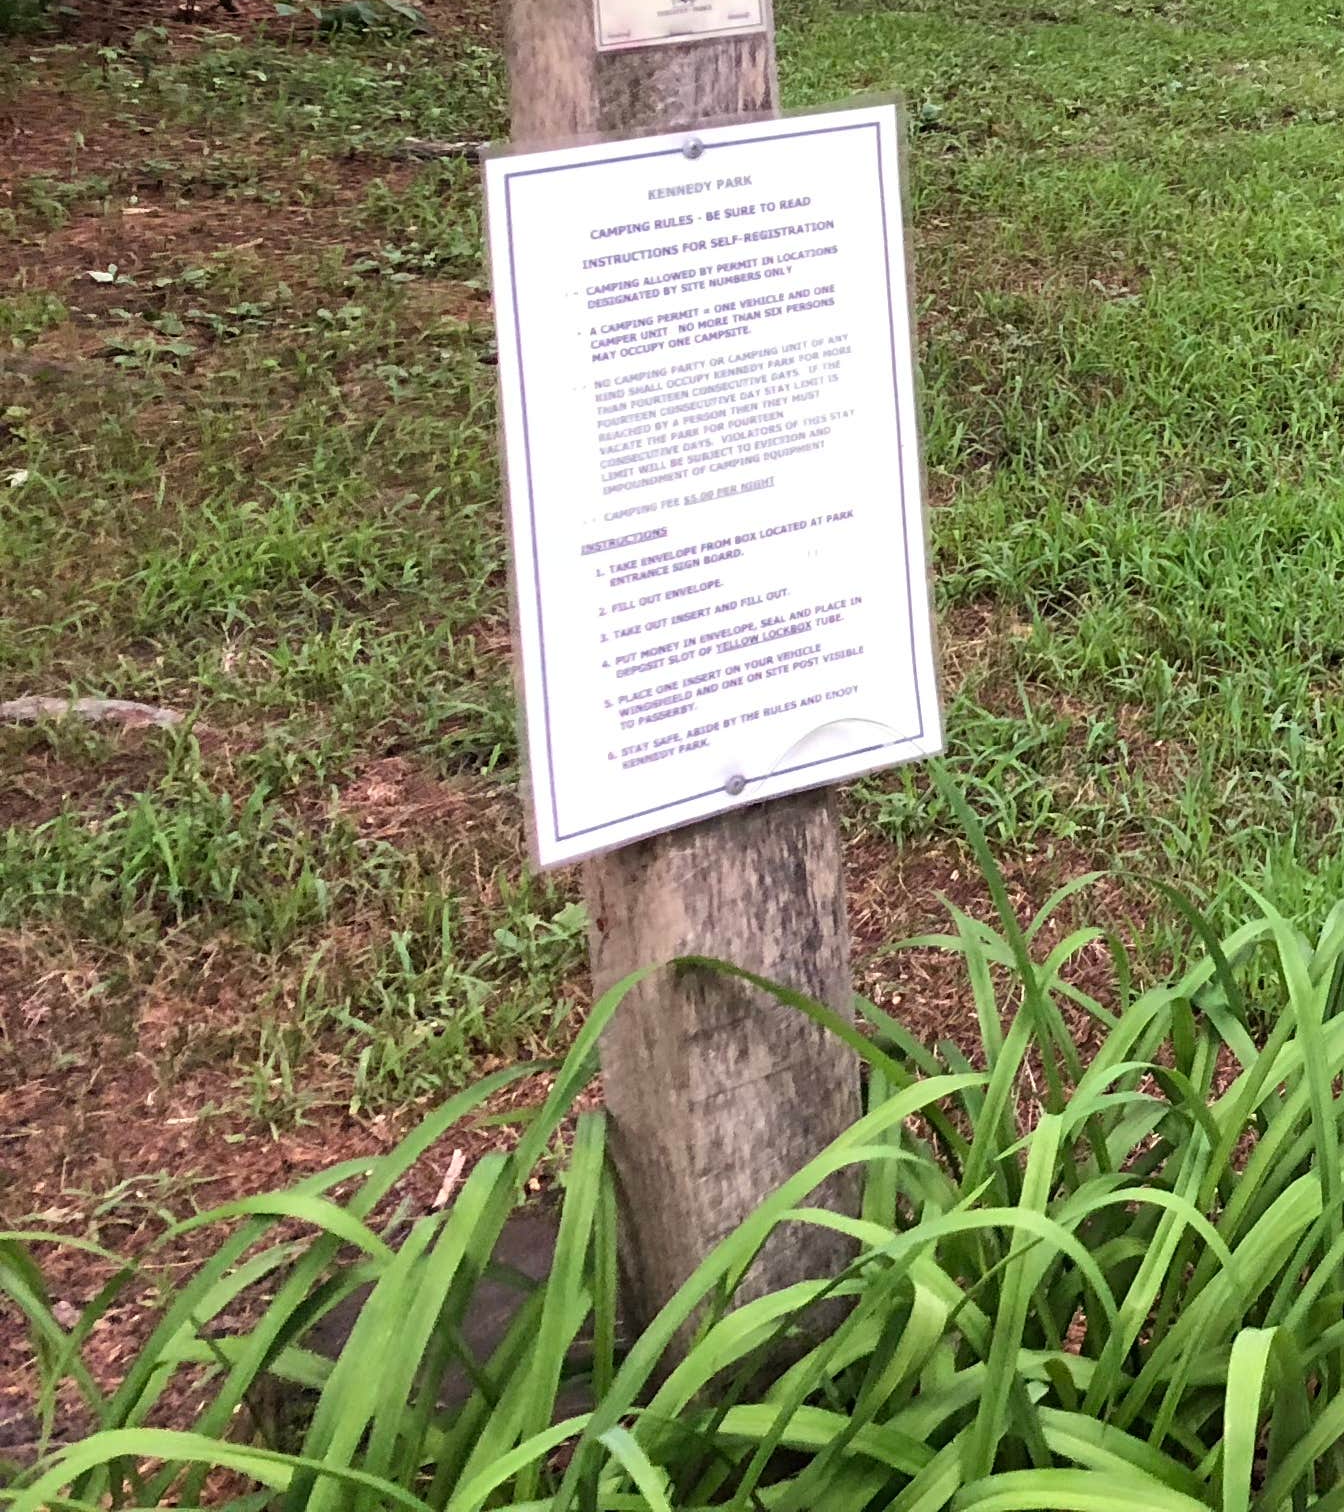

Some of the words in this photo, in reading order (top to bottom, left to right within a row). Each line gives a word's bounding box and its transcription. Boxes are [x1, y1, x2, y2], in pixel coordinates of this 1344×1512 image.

[647, 181, 712, 200] KENNEDY
[716, 175, 753, 190] PARK
[590, 221, 651, 240] CAMPING
[654, 214, 694, 229] RULES
[705, 210, 721, 222] BE
[723, 205, 756, 219] SURE
[759, 202, 776, 213] TO
[779, 197, 812, 210] READ
[582, 245, 679, 269] INSTRUCTIONS
[682, 240, 707, 252] FOR
[710, 220, 835, 248] SELF-REGISTRATION
[586, 278, 640, 296] CAMPING
[643, 269, 697, 285] ALLOWED
[699, 266, 713, 276] BY
[716, 258, 758, 273] PERMIT
[761, 256, 775, 266] IN
[776, 245, 839, 263] LOCATIONS
[587, 288, 661, 309] DESIGNATED
[662, 286, 677, 296] BY
[680, 280, 706, 293] SITE
[708, 271, 762, 287] NUMBERS
[763, 266, 792, 278] ONLY
[589, 327, 597, 335] A
[600, 316, 654, 334] CAMPING
[656, 308, 699, 323] PERMIT
[713, 302, 737, 313] ONE
[739, 293, 785, 309] VEHICLE
[788, 289, 811, 300] AND
[813, 284, 835, 295] ONE
[590, 333, 638, 349] CAMPER
[640, 327, 668, 340] UNIT
[678, 322, 695, 333] NO
[697, 316, 729, 329] MORE
[732, 310, 762, 323] THAN
[764, 306, 783, 318] SIX
[785, 297, 835, 313] PERSONS
[591, 351, 616, 362] MAY
[619, 341, 665, 357] OCCUPY
[667, 336, 691, 348] ONE
[580, 526, 668, 556] INSTRUCTIONS
[609, 560, 638, 573] TAKE
[640, 545, 697, 566] ENVELOPE
[700, 538, 732, 552] FROM
[734, 532, 757, 545] BOX
[759, 520, 808, 539] LOCATED
[810, 516, 823, 527] AT
[826, 510, 854, 523] PARK
[609, 565, 669, 587] ENTRANCE
[672, 558, 701, 572] SIGN
[611, 601, 636, 613] FILL
[638, 593, 662, 606] OUT
[613, 625, 642, 639] TAKE
[644, 618, 668, 631] OUT
[670, 607, 711, 625] INSERT
[714, 601, 738, 614] AND
[740, 595, 764, 607] FILL
[615, 652, 637, 665] PUT
[640, 641, 680, 659] MONEY
[683, 638, 697, 648] IN
[760, 616, 786, 628] SEAL
[789, 608, 812, 621] AND
[814, 599, 847, 614] PLACE
[850, 596, 863, 606] IN
[615, 658, 666, 678] DEPOSIT
[667, 650, 696, 665] SLOT
[698, 646, 713, 657] OF
[715, 634, 760, 654] YELLOW
[762, 621, 812, 643] LOCKBOX
[617, 688, 654, 704] PLACE
[655, 681, 679, 694] ONE
[682, 669, 722, 687] INSERT
[724, 665, 741, 675] ON
[744, 656, 774, 670] YOUR
[776, 643, 822, 662] VEHICLE
[618, 691, 693, 717] WINDSHIELD
[696, 683, 719, 696] AND
[721, 677, 744, 689] ONE
[746, 672, 763, 683] ON
[765, 664, 789, 678] SITE
[792, 656, 819, 670] POST
[822, 645, 864, 663] VISIBLE
[619, 719, 635, 730] TO
[621, 742, 649, 757] STAY
[686, 722, 720, 738] ABIDE
[722, 717, 737, 728] BY
[740, 710, 760, 723] THE
[762, 701, 798, 717] RULES
[799, 694, 823, 707] AND
[622, 747, 676, 769] KENNEDY
